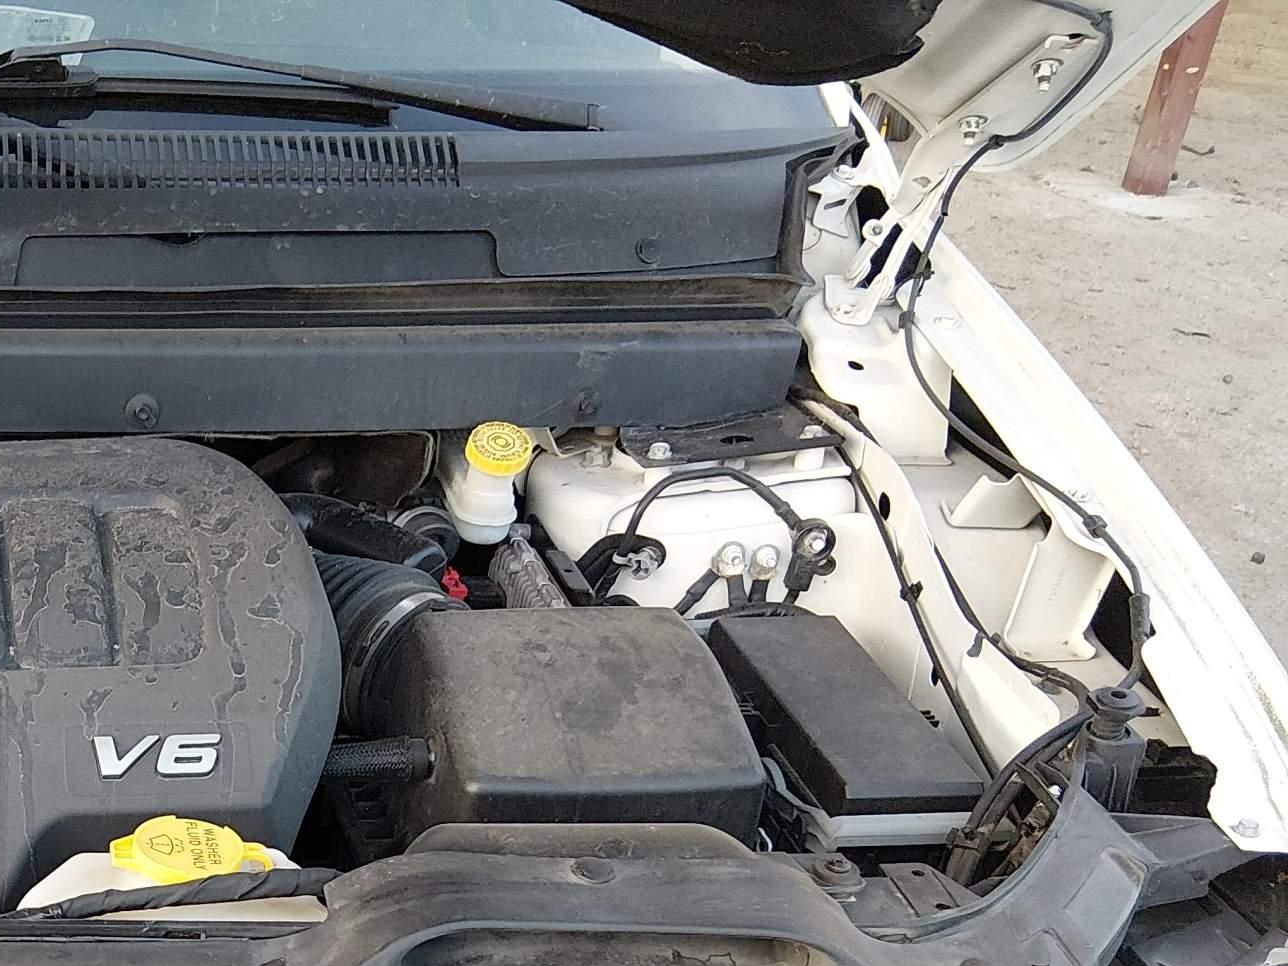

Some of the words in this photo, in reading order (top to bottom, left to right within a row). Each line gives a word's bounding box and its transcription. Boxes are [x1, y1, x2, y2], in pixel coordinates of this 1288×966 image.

[93, 733, 222, 778] V6
[185, 821, 201, 847] FLUID
[203, 828, 222, 865] WASHER
[190, 848, 208, 871] ONLY
